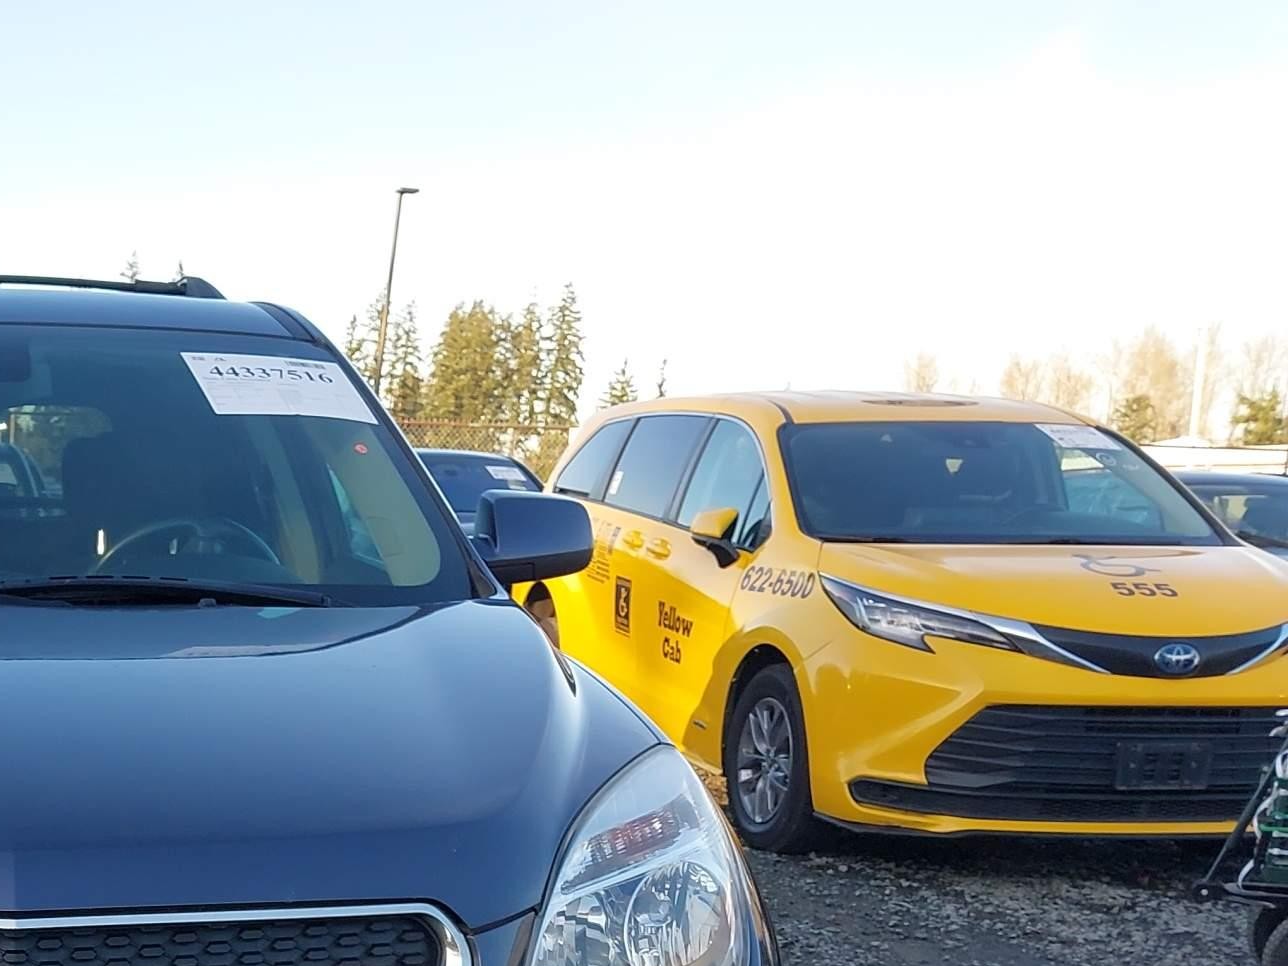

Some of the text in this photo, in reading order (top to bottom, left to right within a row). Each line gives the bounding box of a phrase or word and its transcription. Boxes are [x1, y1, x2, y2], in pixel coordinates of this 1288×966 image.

[209, 365, 333, 384] 44337516
[740, 565, 816, 600] 622-6500
[1110, 582, 1179, 597] 555
[658, 601, 693, 637] Yellow
[663, 637, 681, 664] Cab
